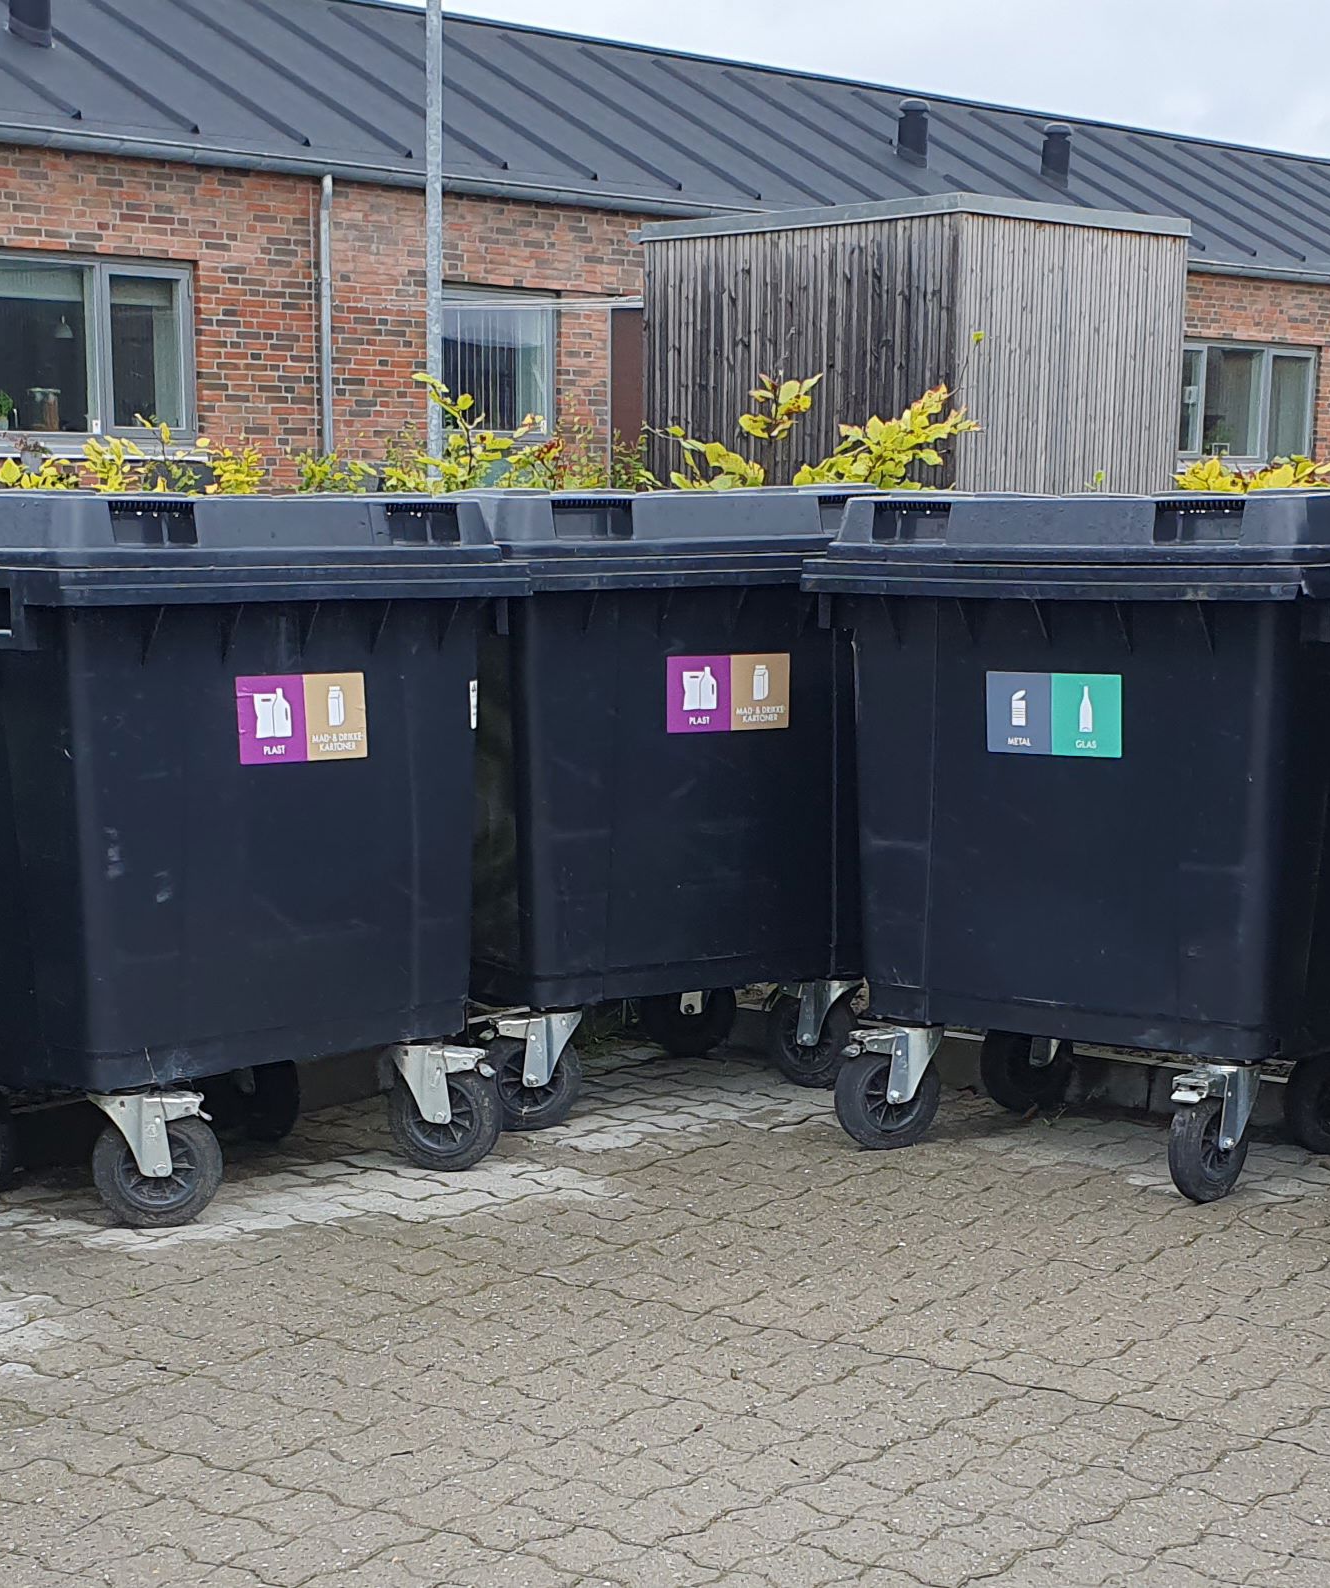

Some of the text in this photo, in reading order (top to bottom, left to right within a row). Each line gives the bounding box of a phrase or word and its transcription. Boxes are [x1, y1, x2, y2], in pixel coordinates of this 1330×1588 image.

[689, 717, 710, 725] PLAST
[1008, 738, 1031, 746] METAL
[1076, 740, 1097, 748] GLAS
[264, 745, 286, 755] PLAST
[320, 742, 356, 752] KARTONER
